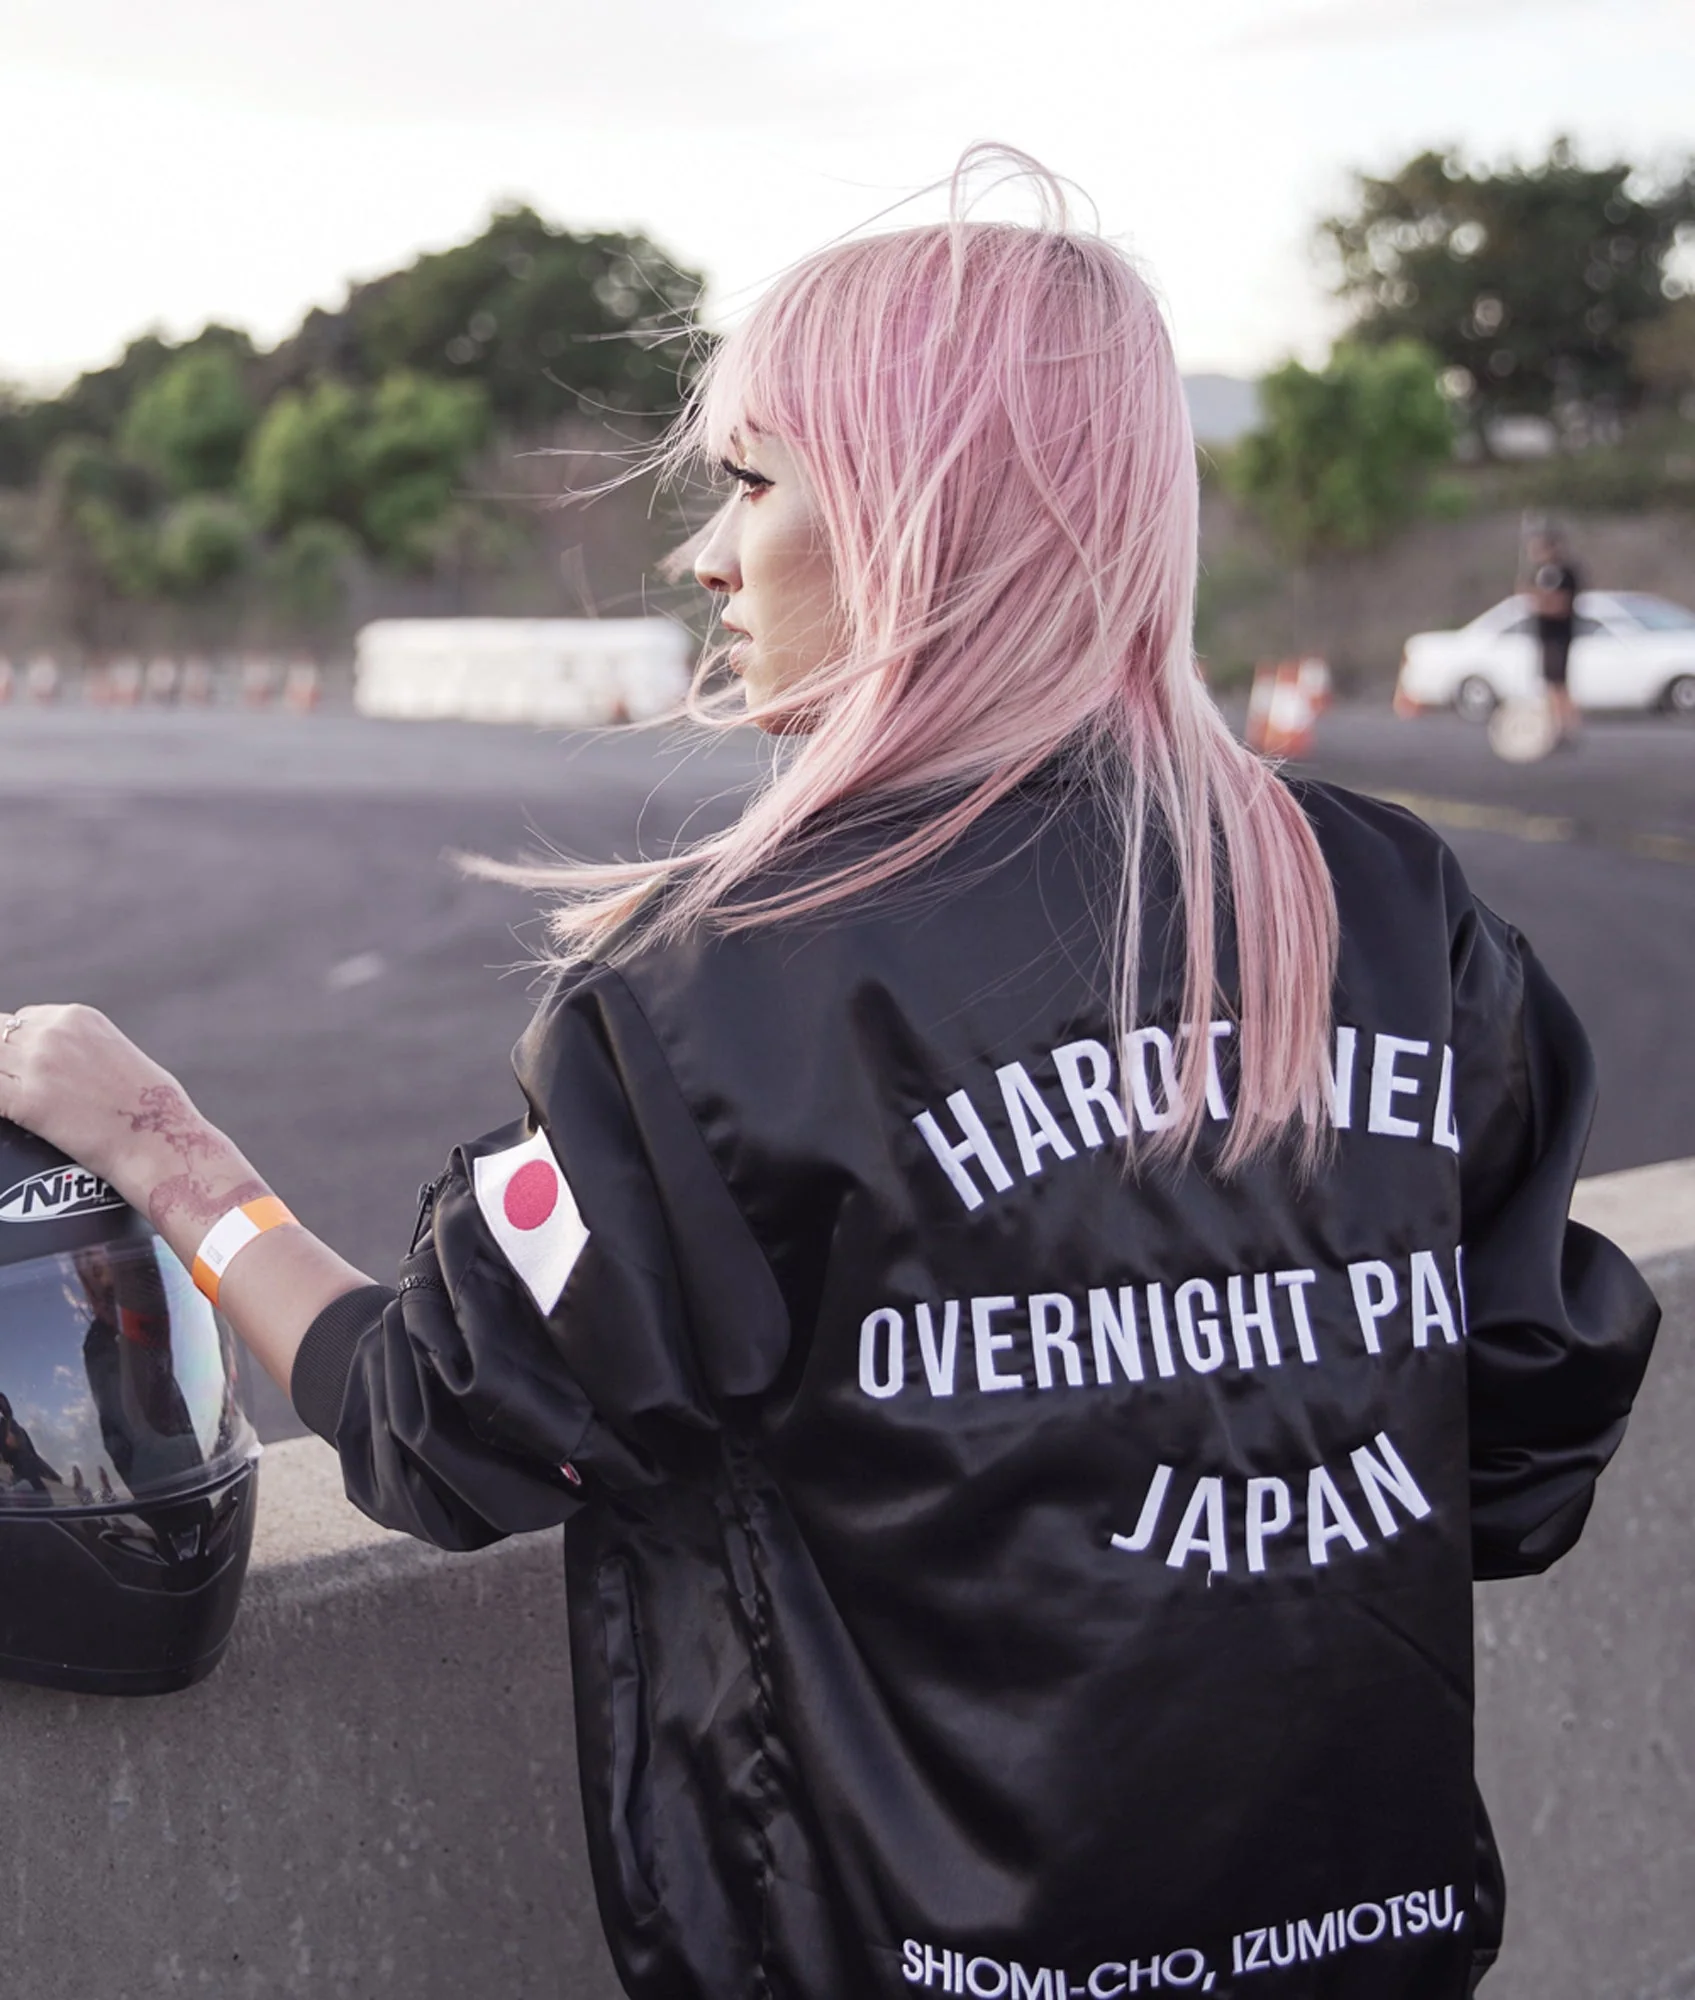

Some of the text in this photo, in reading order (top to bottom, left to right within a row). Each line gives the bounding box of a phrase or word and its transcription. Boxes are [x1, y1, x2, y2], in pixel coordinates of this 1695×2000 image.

[858, 1245, 1467, 1399] OVERNIGHT PA
[1110, 1431, 1432, 1574] JAPAN
[901, 1885, 1465, 2000] SHIOMI-CHO, IZUMIOTSU,
